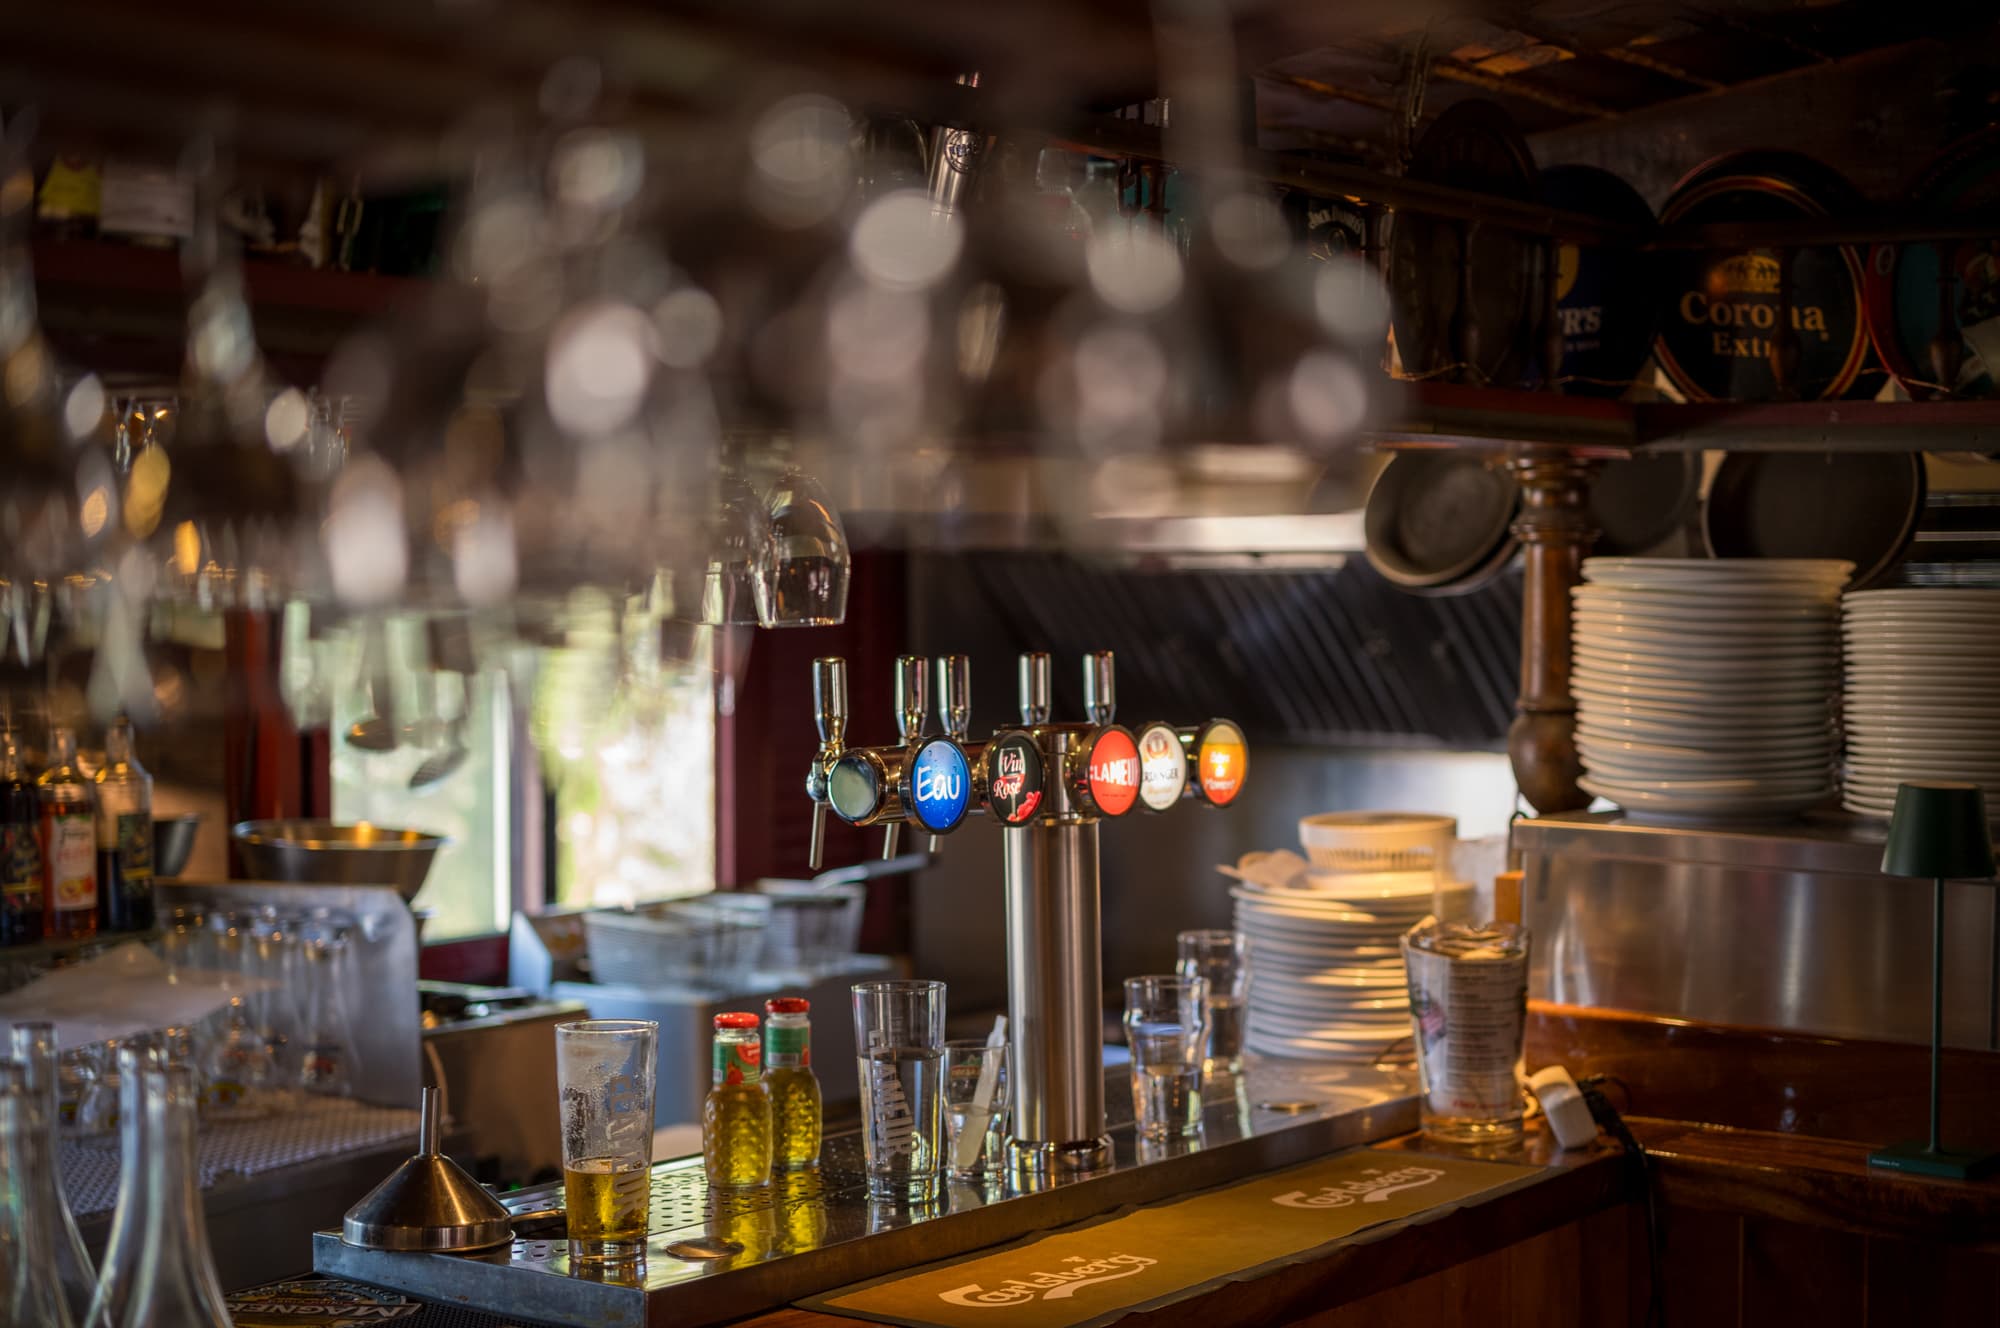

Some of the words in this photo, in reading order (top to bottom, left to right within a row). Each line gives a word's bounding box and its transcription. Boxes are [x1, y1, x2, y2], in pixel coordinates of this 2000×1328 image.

[1003, 753, 1023, 773] Vin
[917, 766, 960, 801] Eau
[1271, 1166, 1446, 1209] Carlsberg
[938, 1253, 1159, 1308] Carlsberg
[226, 1303, 399, 1317] MAGNER
